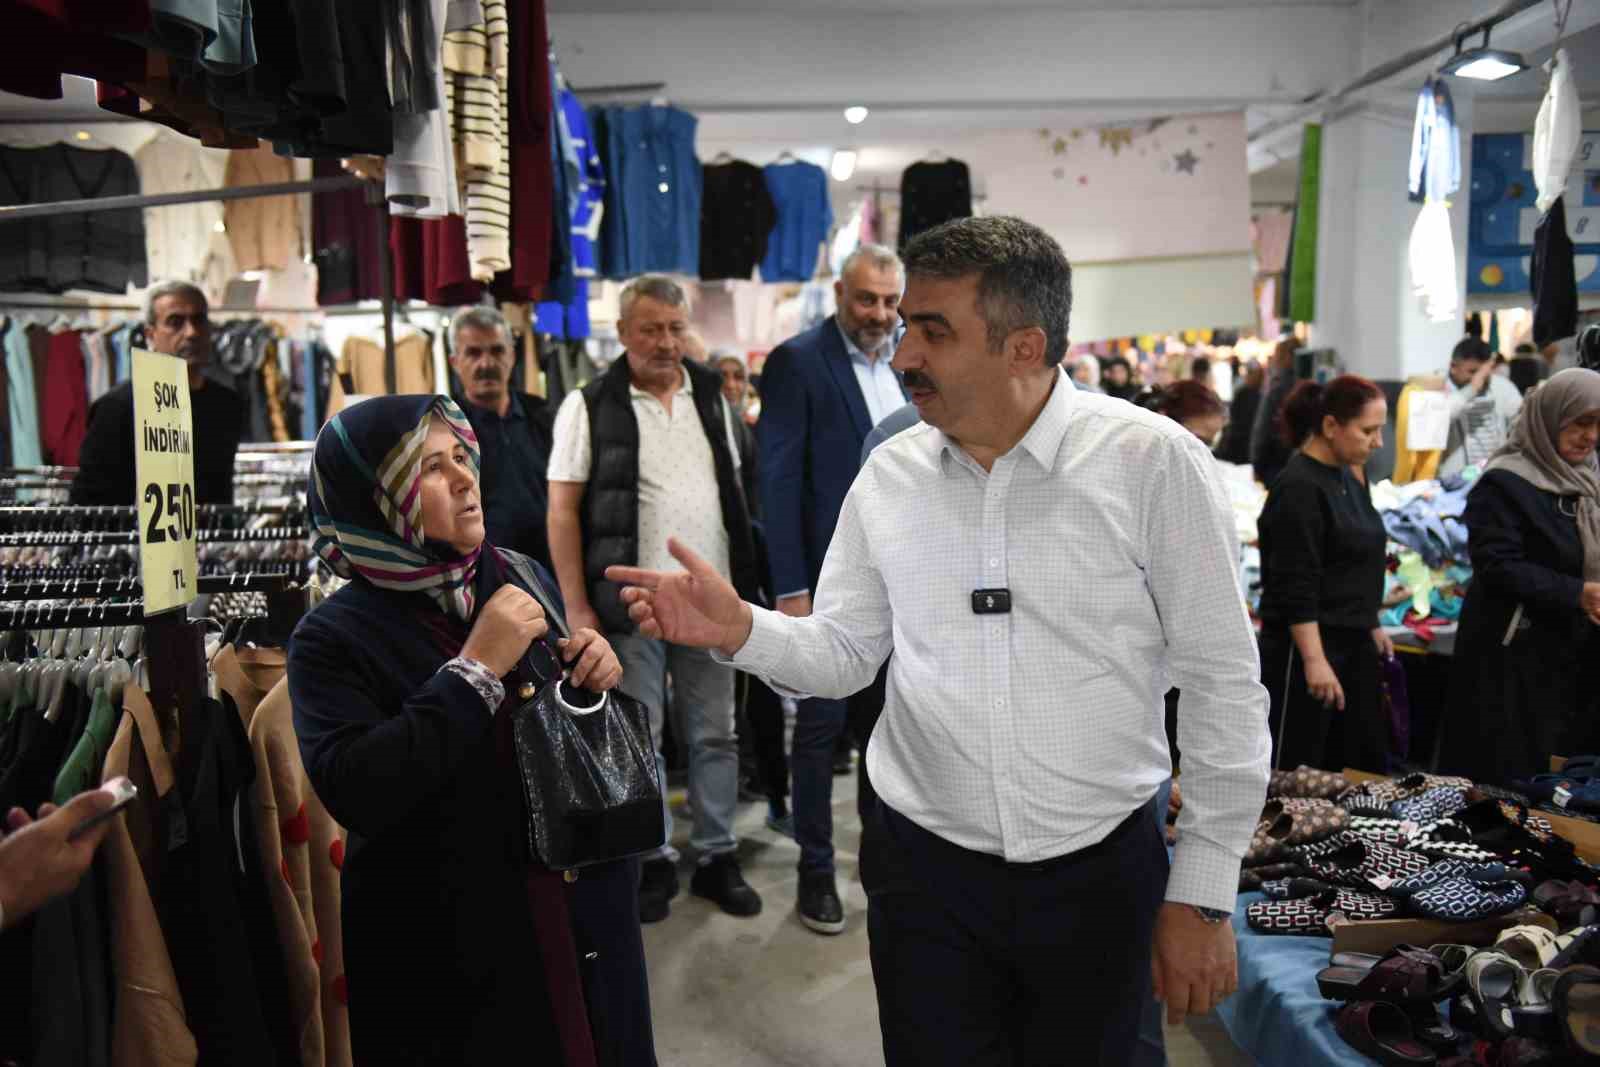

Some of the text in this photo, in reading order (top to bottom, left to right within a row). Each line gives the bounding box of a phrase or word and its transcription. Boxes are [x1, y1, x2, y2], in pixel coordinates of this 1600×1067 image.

[154, 381, 180, 412] ŞOK
[144, 420, 190, 454] İNDİRİM
[145, 483, 193, 544] 250
[172, 569, 186, 590] TL
